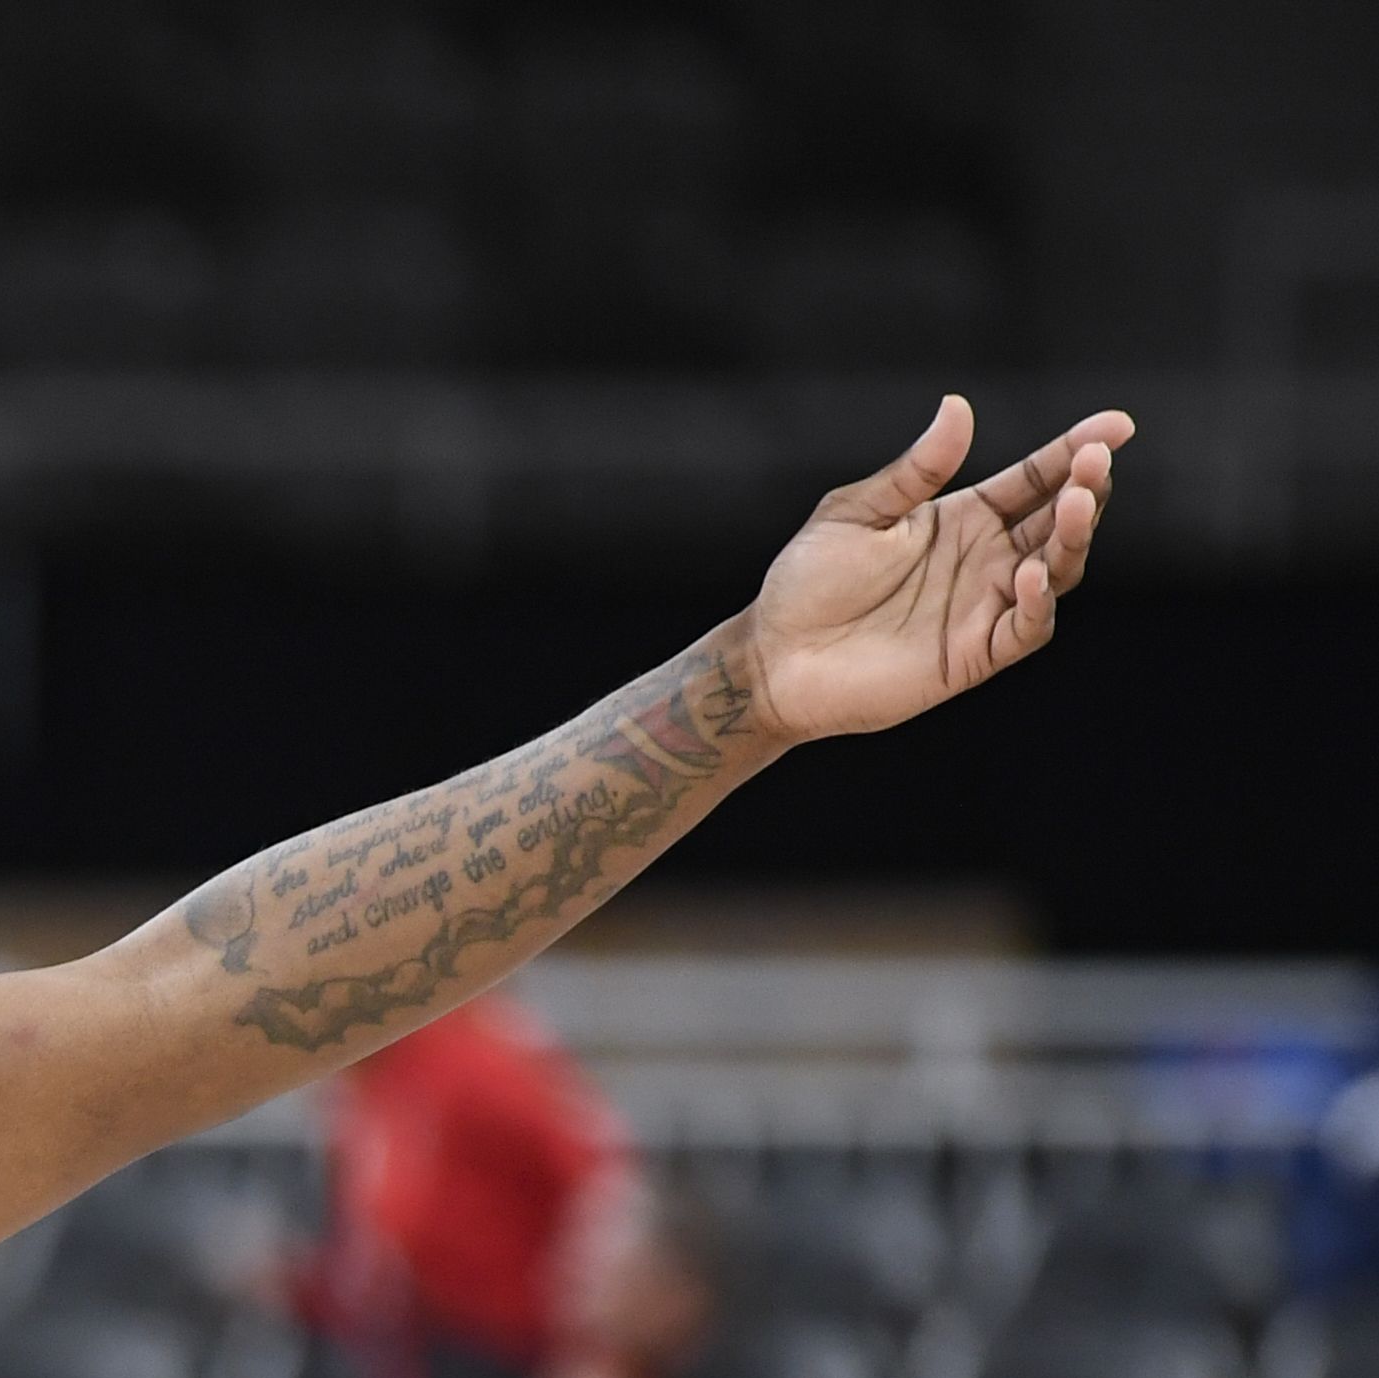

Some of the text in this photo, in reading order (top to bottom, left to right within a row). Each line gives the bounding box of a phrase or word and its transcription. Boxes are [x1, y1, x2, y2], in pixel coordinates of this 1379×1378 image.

[468, 810, 510, 848] you
[307, 911, 359, 955] and
[364, 870, 452, 928] change
[463, 847, 505, 884] the
